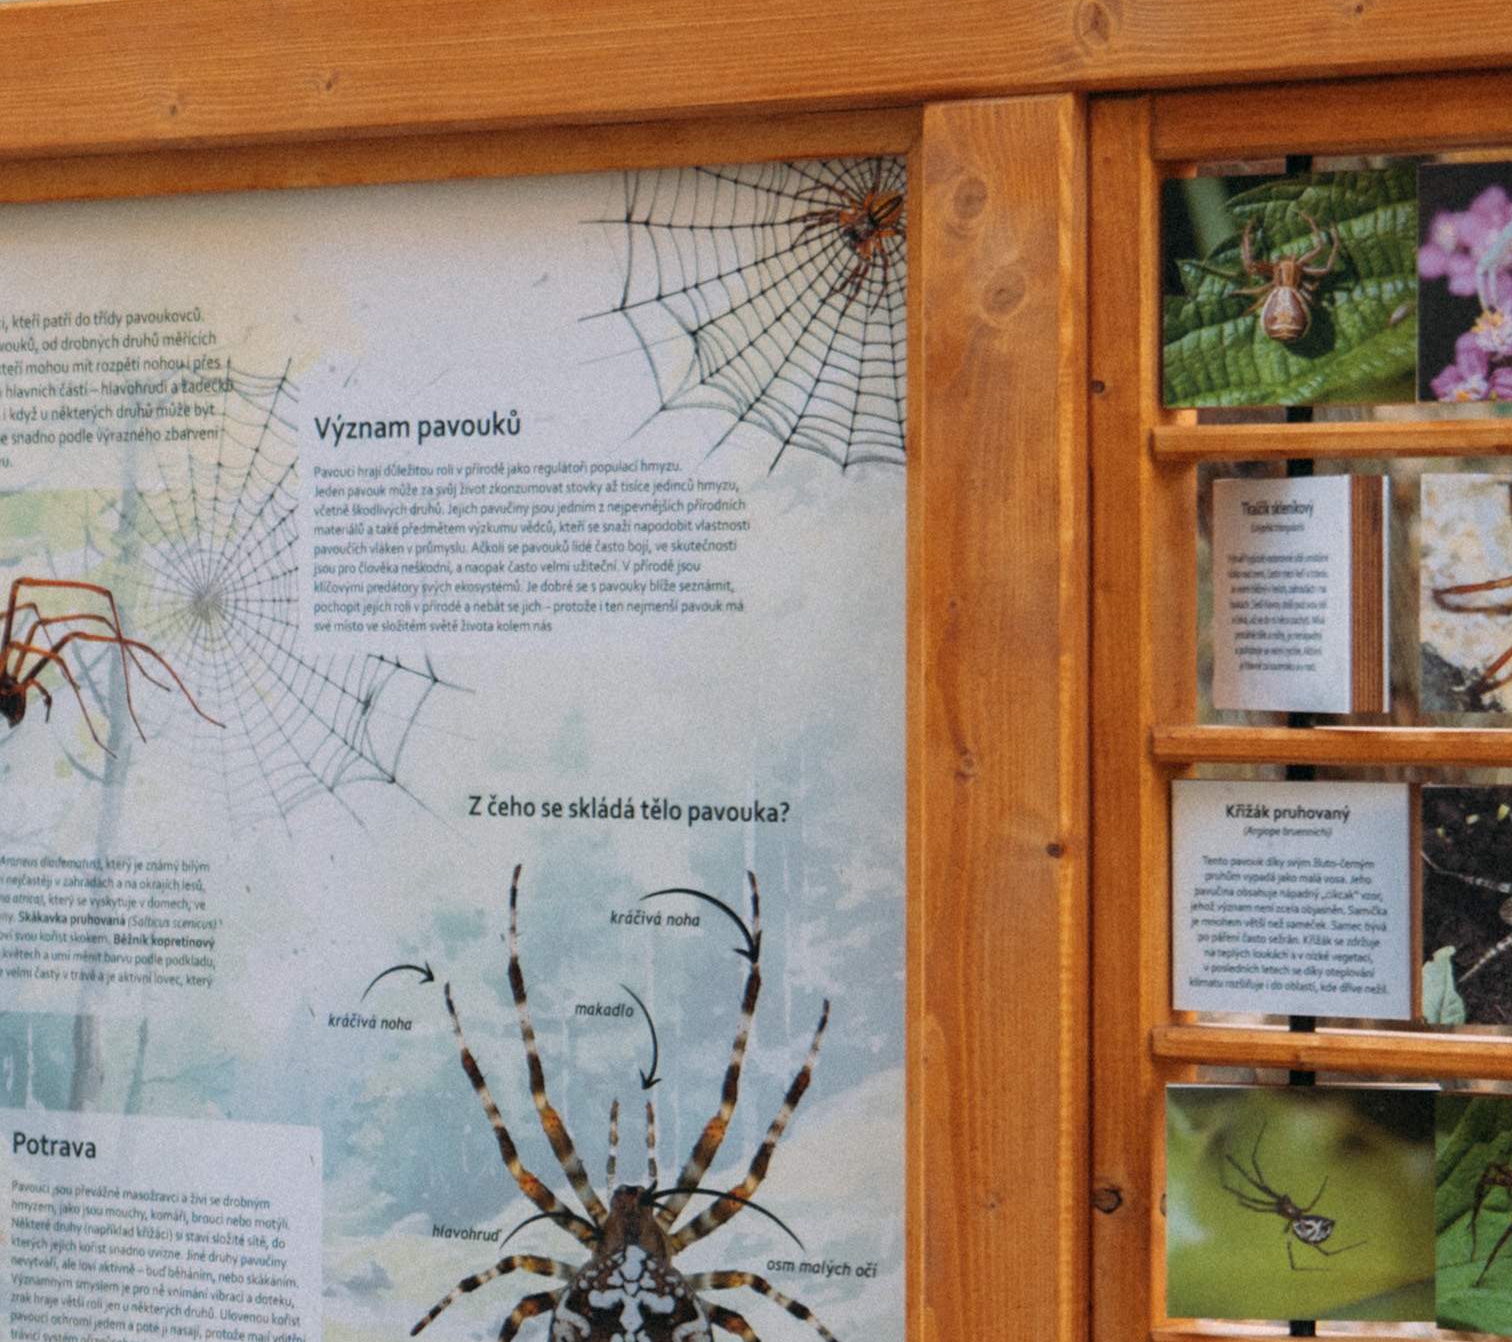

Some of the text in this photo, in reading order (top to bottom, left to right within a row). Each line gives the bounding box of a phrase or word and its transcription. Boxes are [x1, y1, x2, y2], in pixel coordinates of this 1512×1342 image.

[11, 313, 41, 329] kteří
[42, 312, 72, 332] patří
[93, 310, 122, 330] třídy
[60, 333, 120, 354] drobných
[122, 332, 160, 348] druhů
[161, 330, 216, 347] měřících
[314, 409, 521, 447] Význam pavouků
[314, 463, 356, 477] Pavouci
[356, 462, 382, 479] hrají
[436, 461, 454, 475] roli
[464, 460, 506, 478] přírodě
[506, 459, 530, 477] jako
[590, 458, 638, 476] populací
[640, 457, 680, 475] hmyzu.
[314, 482, 346, 496] Jeden
[346, 481, 386, 499] pavouk
[388, 481, 418, 495] může
[436, 480, 458, 498] svůj
[460, 480, 486, 494] život
[566, 478, 602, 496] stovky
[620, 478, 650, 492] tisíce
[652, 477, 694, 495] jedinců
[696, 477, 740, 494] hmyzu,
[314, 501, 350, 515] včetně
[408, 500, 442, 514] druhů.
[448, 500, 478, 517] Jejich
[480, 499, 530, 517] pavučiny
[530, 500, 556, 516] jsou
[556, 498, 596, 516] jedním
[376, 520, 400, 534] také
[468, 519, 518, 536] výzkumu
[520, 518, 556, 535] vědců,
[558, 518, 586, 532] kteří
[602, 517, 632, 532] snaží
[468, 795, 790, 827] Z čeho se skládá tělo pavouka?
[1226, 804, 1351, 824] Křižák pruhovaný
[610, 910, 700, 927] kráčivá noha
[574, 1003, 634, 1018] makadlo
[328, 1013, 412, 1031] kráčivá noha
[12, 1132, 97, 1159] Potrava
[432, 1225, 501, 1242] hlavohruď
[766, 1259, 878, 1278] osm malých očí
